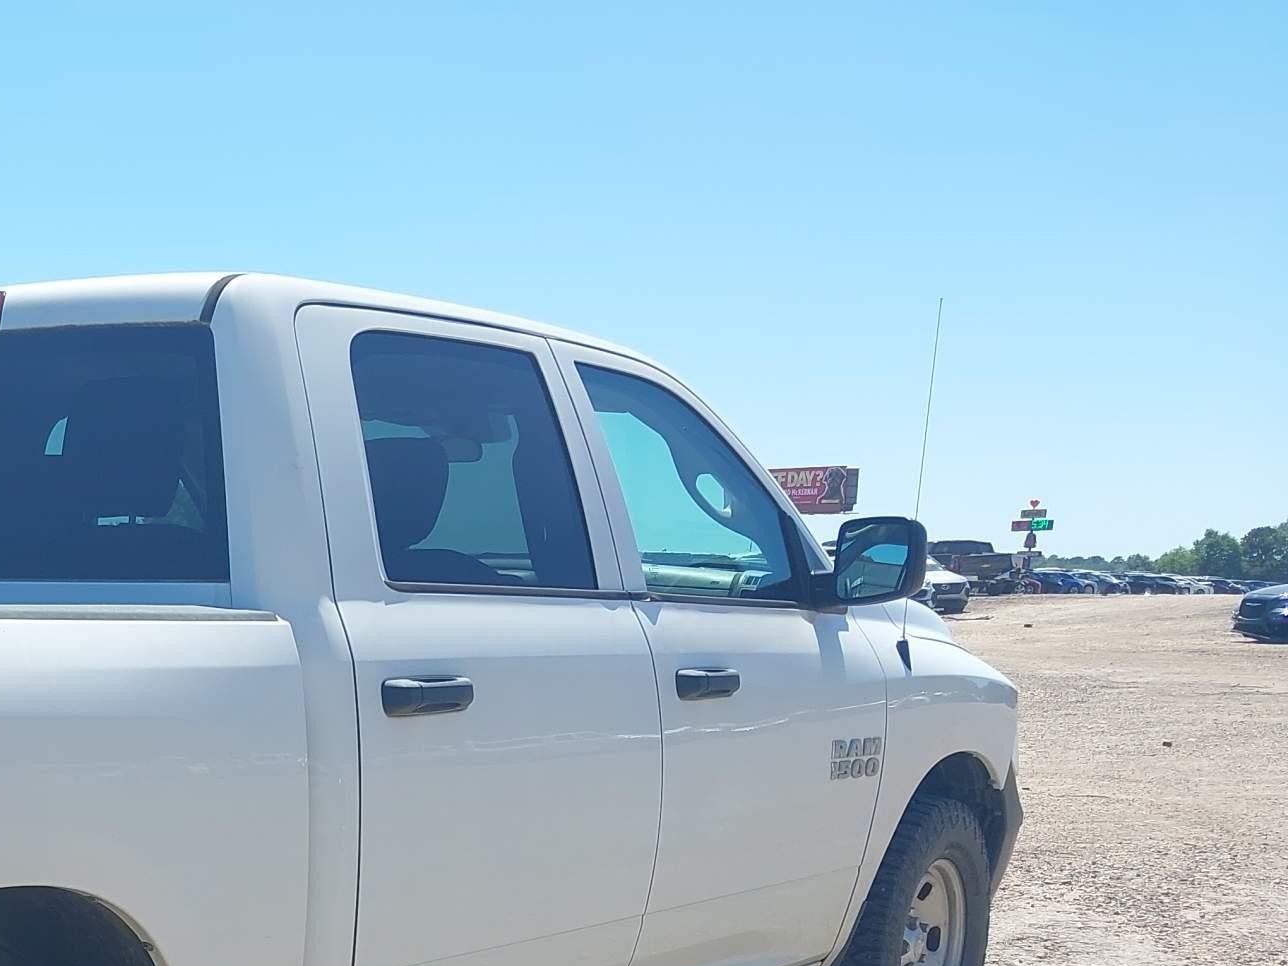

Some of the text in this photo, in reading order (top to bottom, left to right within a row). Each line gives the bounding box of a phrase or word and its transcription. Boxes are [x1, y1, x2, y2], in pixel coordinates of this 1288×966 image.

[787, 470, 823, 487] DAY?
[831, 737, 882, 759] RAM
[830, 757, 879, 780] 1500
